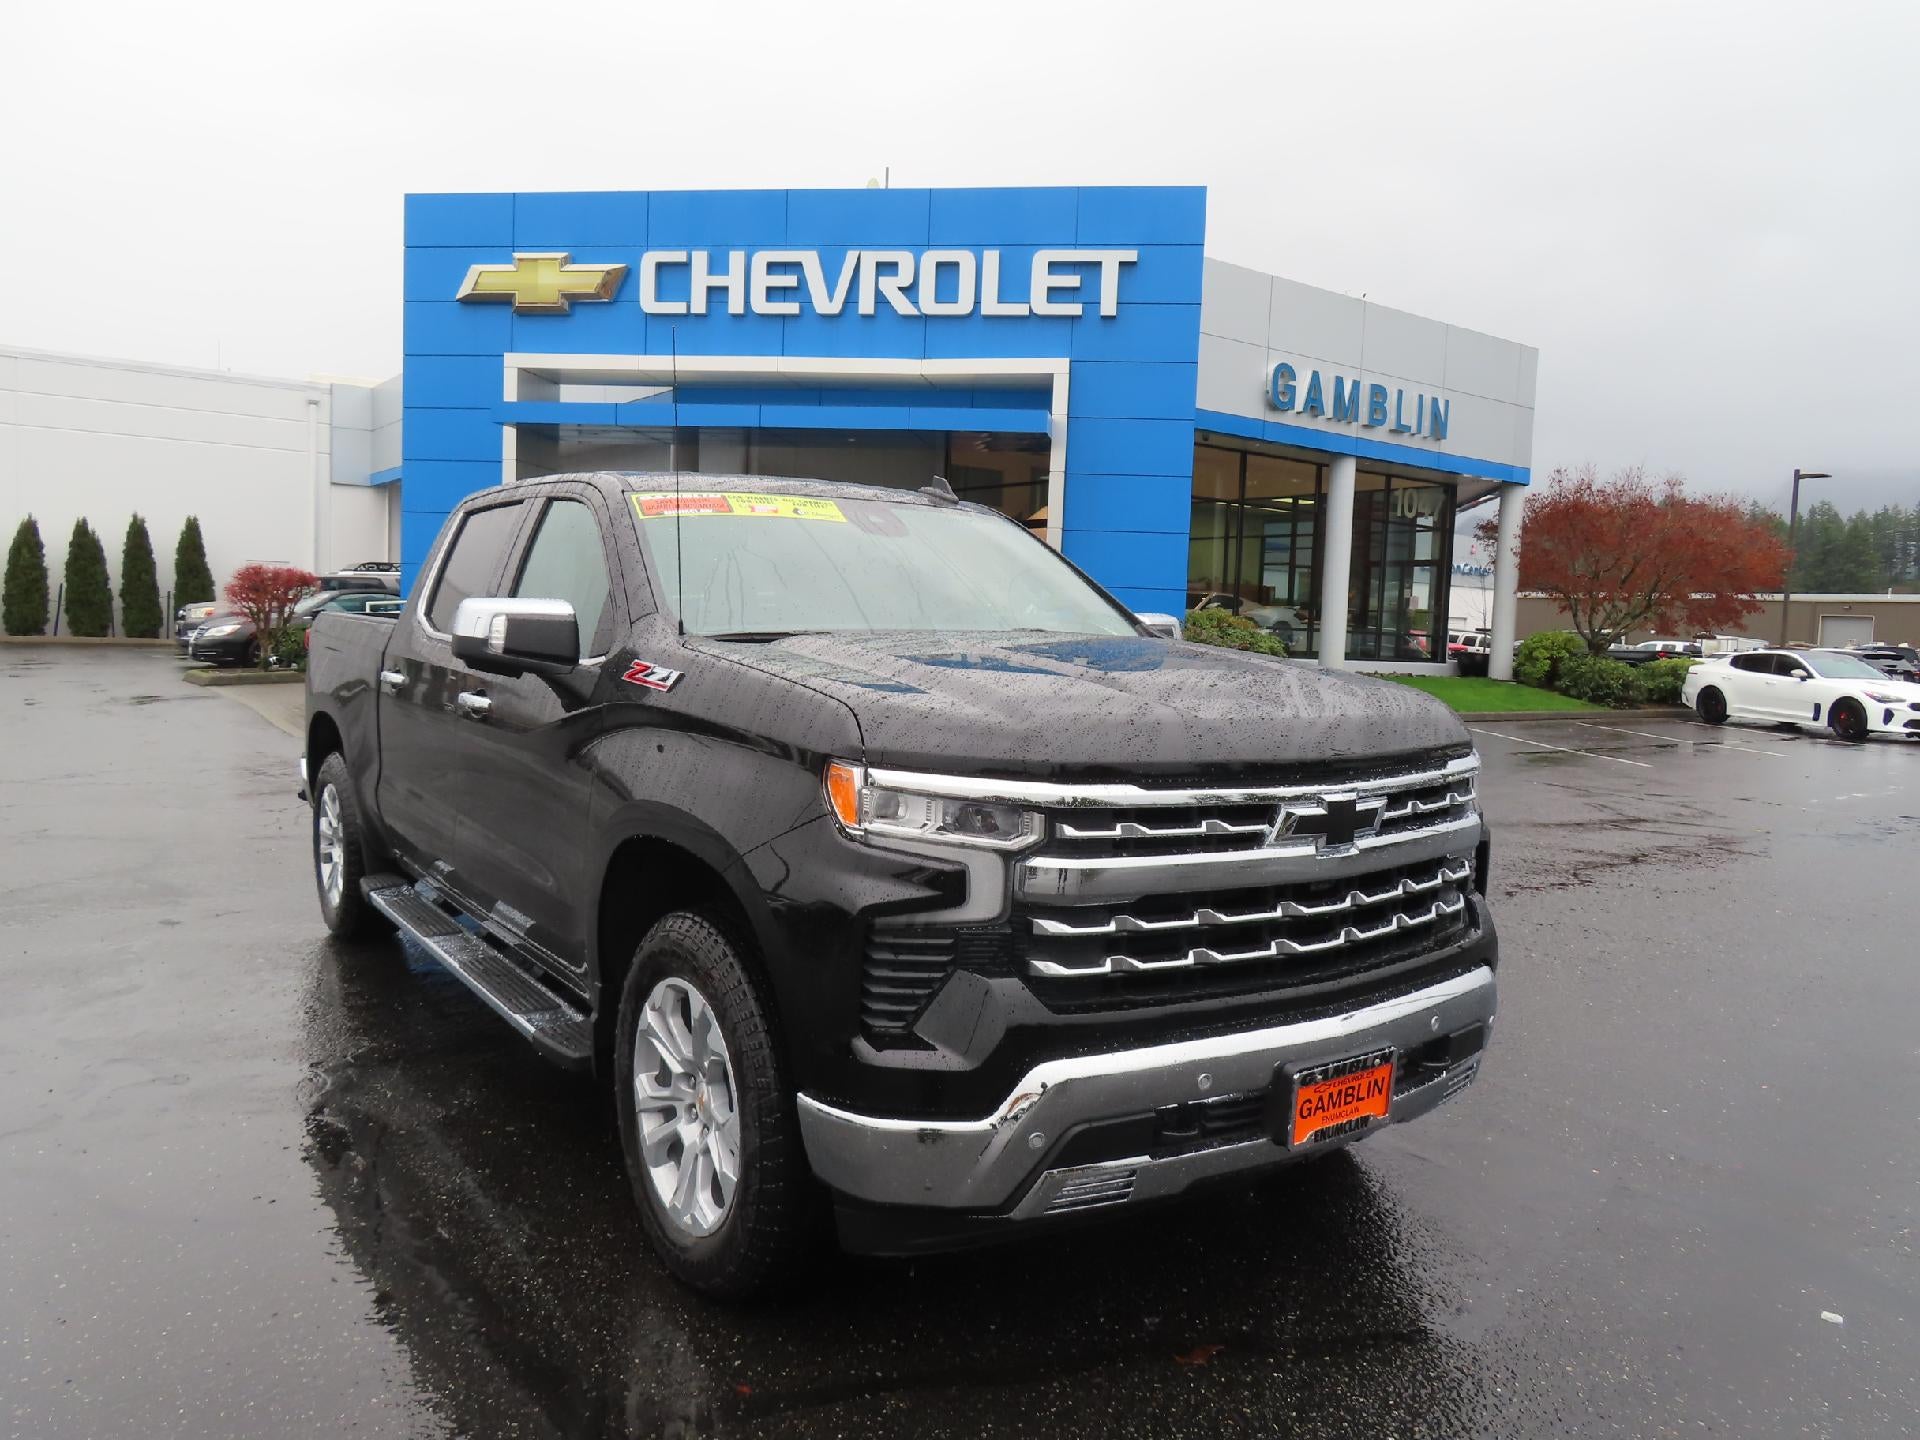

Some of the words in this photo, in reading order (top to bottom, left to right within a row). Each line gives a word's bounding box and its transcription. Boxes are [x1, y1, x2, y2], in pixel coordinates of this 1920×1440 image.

[639, 249, 1138, 317] CHEVROLET
[1269, 361, 1450, 441] GAMBLIN
[1392, 487, 1447, 521] 1047
[1299, 1076, 1386, 1120] GAMBLIN
[1313, 1114, 1370, 1143] ENUMCLAW
